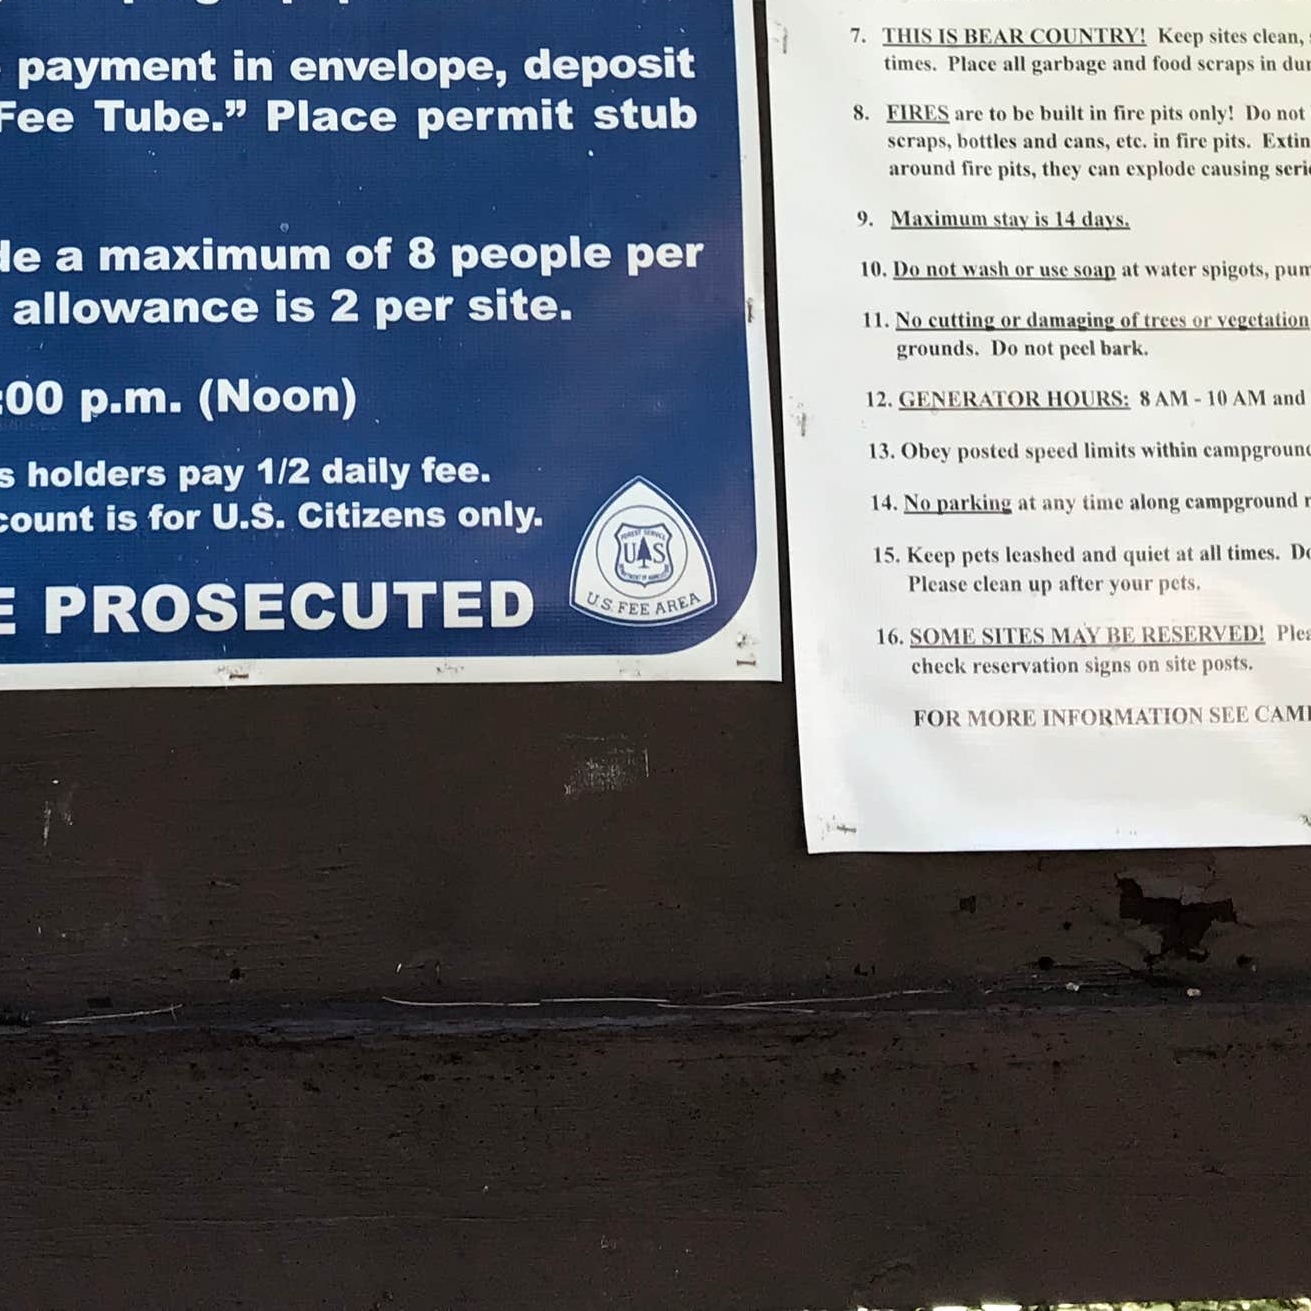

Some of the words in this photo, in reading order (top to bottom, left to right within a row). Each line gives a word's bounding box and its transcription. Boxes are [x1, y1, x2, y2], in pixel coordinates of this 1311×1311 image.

[19, 50, 216, 89] payment
[234, 50, 272, 81] in
[290, 50, 506, 88] envelope,
[524, 47, 695, 87] deposit
[856, 210, 874, 227] 9.
[891, 209, 988, 231] Maximum
[993, 212, 1029, 232] stay
[1034, 210, 1049, 231] is
[1056, 210, 1076, 231] 14
[1081, 210, 1130, 232] days.
[82, 388, 181, 422] p.m.
[200, 378, 356, 421] (Noon)
[869, 442, 895, 460] 13.
[900, 442, 951, 464] Obey
[957, 442, 1019, 464] posted
[1025, 441, 1078, 464] speed
[1084, 441, 1136, 459] limits
[1140, 441, 1198, 458] within
[107, 505, 137, 530] is
[148, 504, 201, 530] for
[213, 503, 284, 529] U.S.
[299, 502, 446, 528] Citizens
[458, 501, 542, 533] only.
[908, 575, 968, 593] Please
[973, 574, 1022, 593] clean
[1028, 579, 1053, 595] up
[1059, 574, 1104, 592] after
[1109, 578, 1154, 595] your
[1159, 575, 1201, 595] pets.
[46, 581, 533, 633] PROSECUTED
[617, 602, 649, 616] FEE
[655, 592, 701, 615] AREA
[911, 656, 967, 675] check
[972, 656, 1079, 675] reservation
[1085, 655, 1131, 678] signs
[1137, 659, 1160, 673] on
[1165, 654, 1197, 672] site
[1202, 655, 1254, 677] posts.
